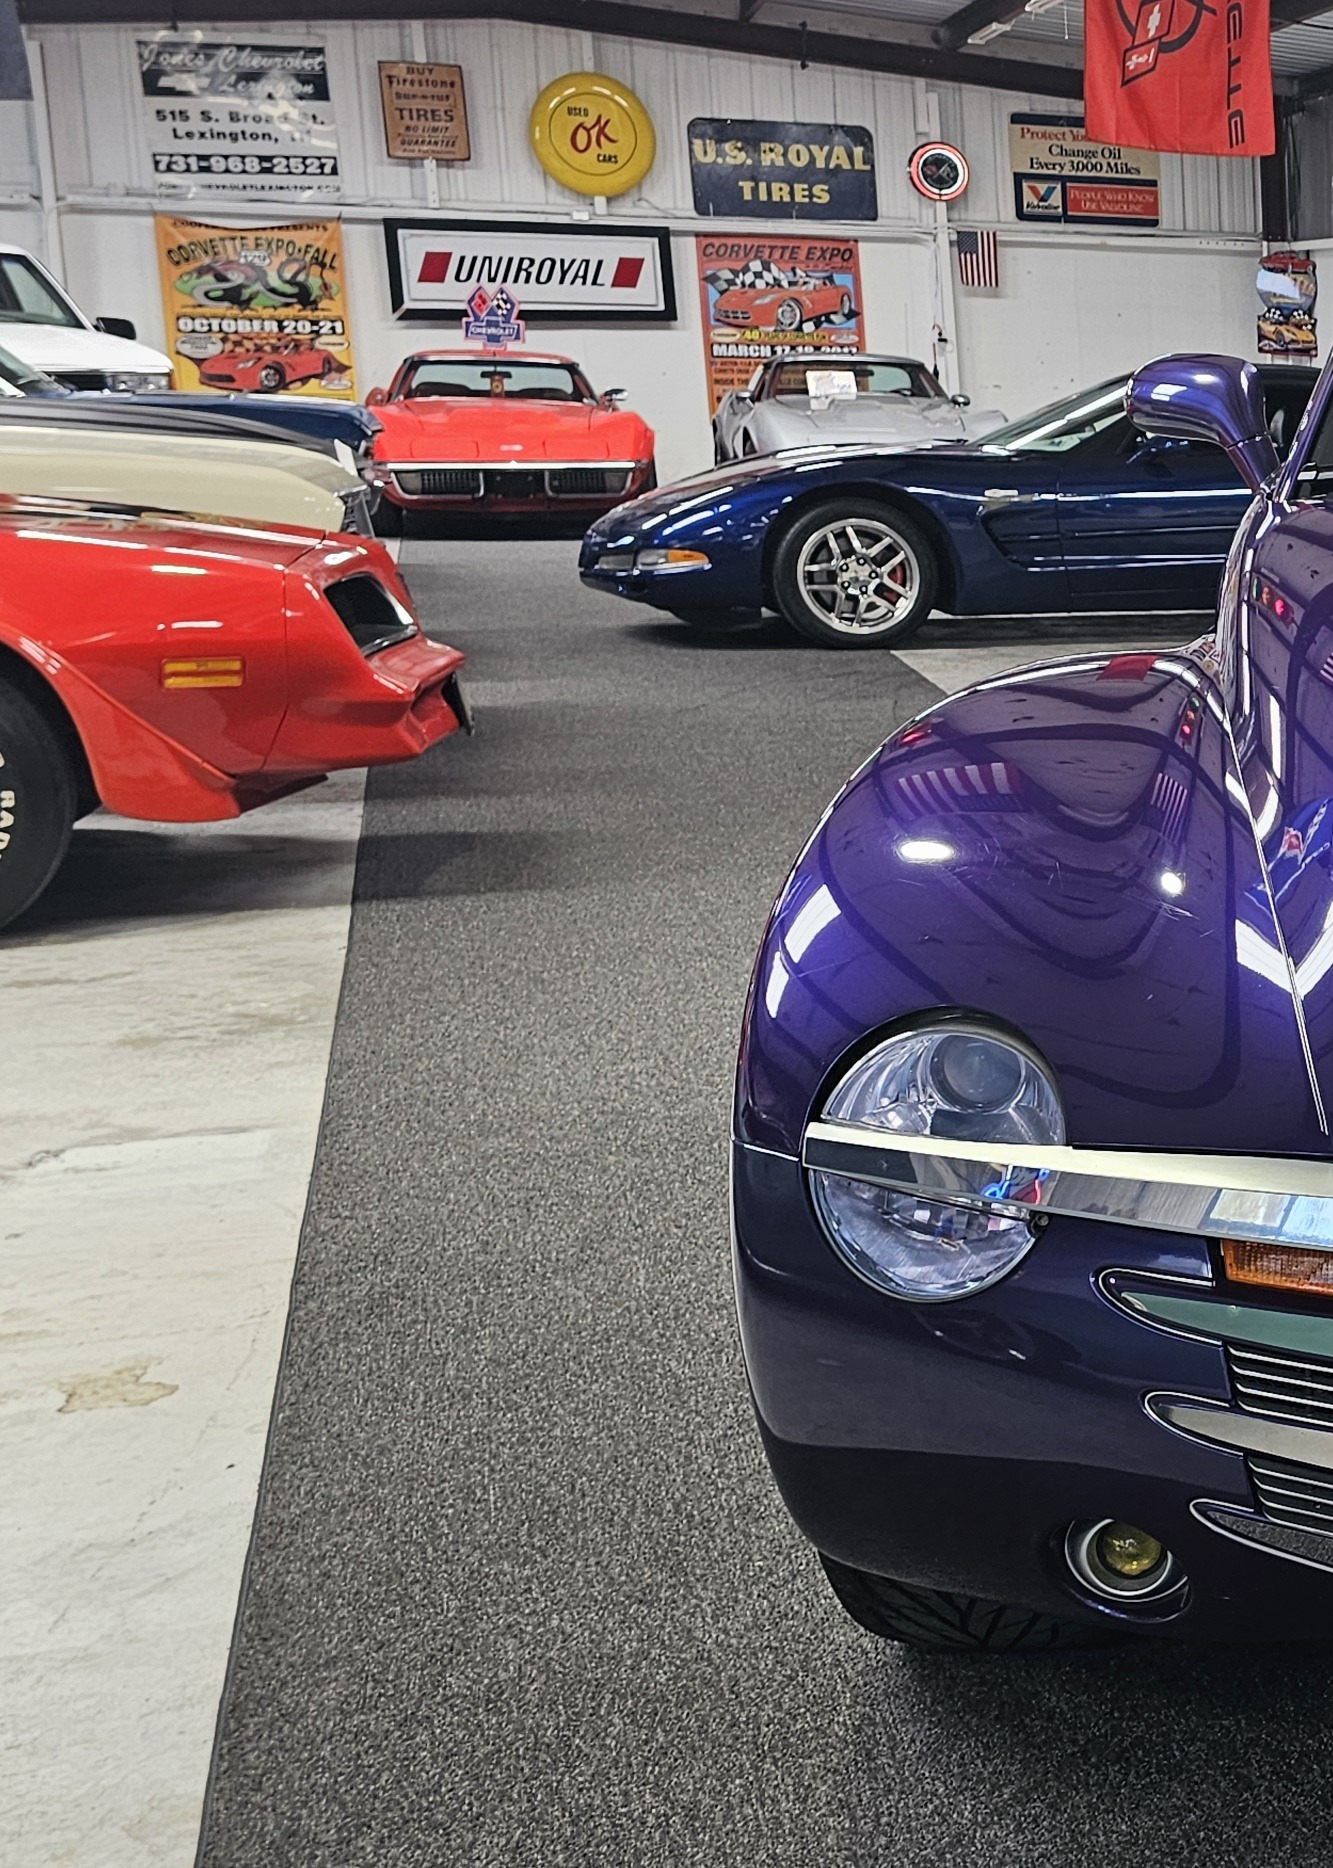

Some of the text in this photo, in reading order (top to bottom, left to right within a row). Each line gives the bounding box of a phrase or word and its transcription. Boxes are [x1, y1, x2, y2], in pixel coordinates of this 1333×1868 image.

[217, 45, 325, 73] Chevrolet
[406, 66, 434, 76] BUY
[1227, 0, 1245, 149] ETTE
[218, 74, 315, 98] Lexington
[385, 74, 456, 89] Firestone
[155, 109, 190, 123] 515
[200, 110, 220, 123] S.
[228, 110, 291, 125] Bro
[395, 106, 454, 122] TIRES
[567, 106, 589, 117] USED
[172, 127, 280, 144] Lexington,
[421, 126, 450, 134] LIMIT
[570, 113, 619, 154] OK
[1020, 127, 1066, 142] Protect
[400, 138, 456, 148] GUARANTEE
[1048, 143, 1122, 160] Change Oil
[596, 153, 619, 164] CARS
[692, 138, 871, 171] U.S. ROYAL
[155, 155, 335, 175] 731-968-2527
[1029, 157, 1067, 173] Every
[1106, 161, 1141, 176] Miles
[738, 181, 830, 204] TIRES
[1026, 200, 1060, 212] Valvoline
[166, 235, 250, 267] CORVETTE
[254, 235, 297, 257] EXPO
[702, 242, 854, 262] CORVETTE EXPO
[454, 255, 606, 287] UNIROYAL
[177, 317, 344, 335] OCTOBER 20-21
[713, 344, 772, 358] MARCH
